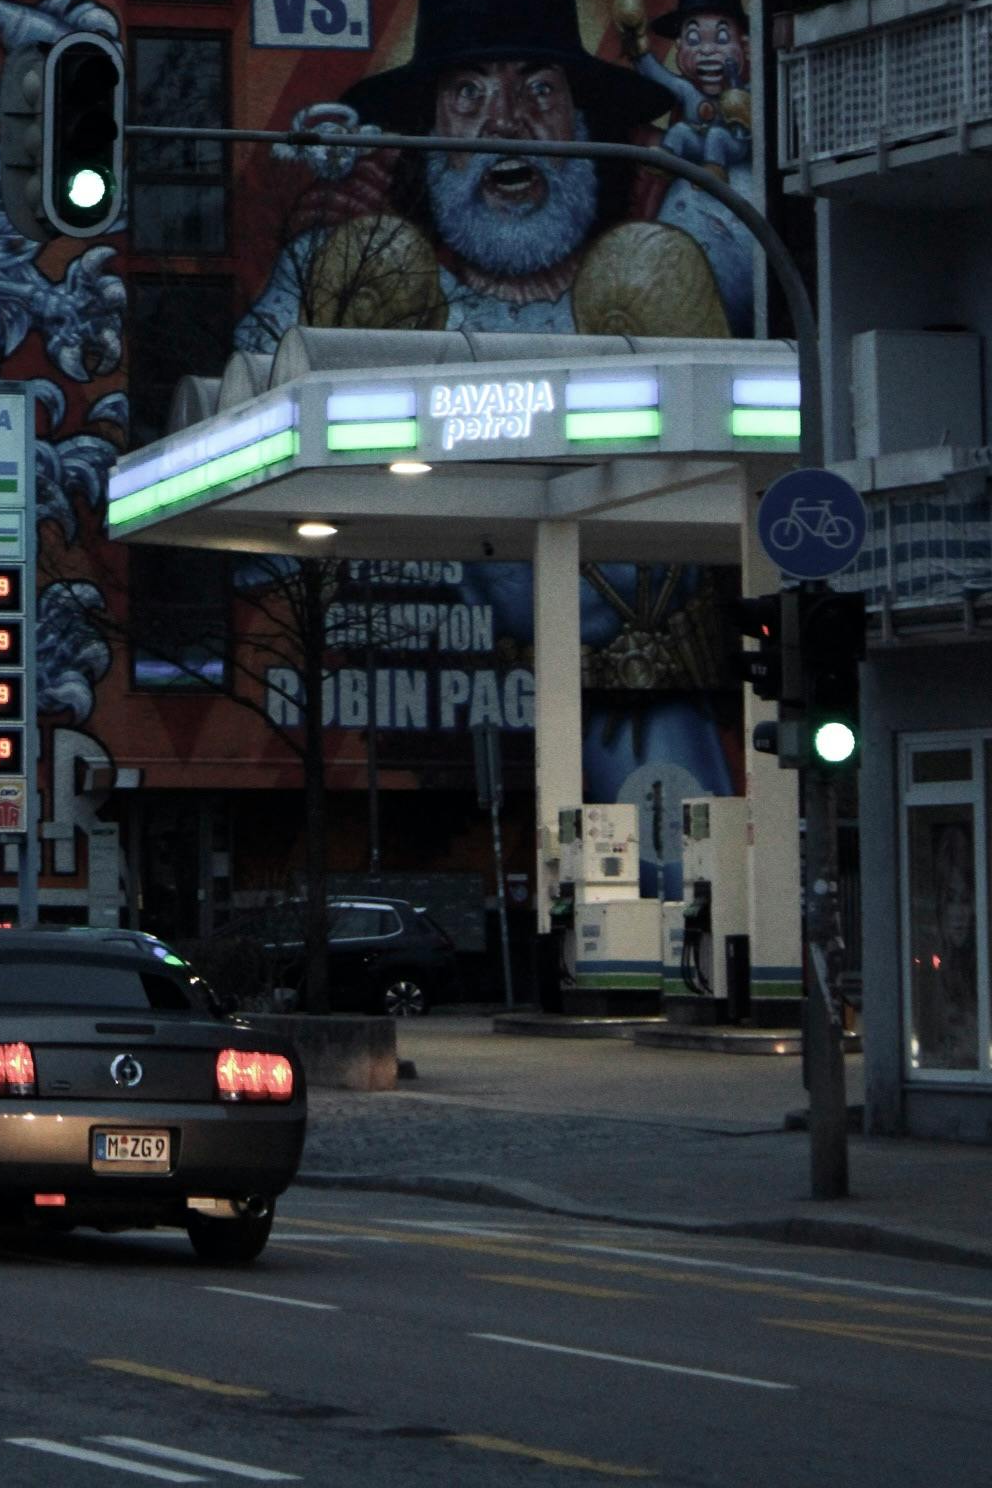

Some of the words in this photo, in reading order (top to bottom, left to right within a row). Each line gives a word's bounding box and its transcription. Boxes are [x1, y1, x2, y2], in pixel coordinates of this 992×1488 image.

[430, 379, 555, 417] BAVARIA
[442, 412, 532, 450] petrol
[107, 1137, 118, 1157] M
